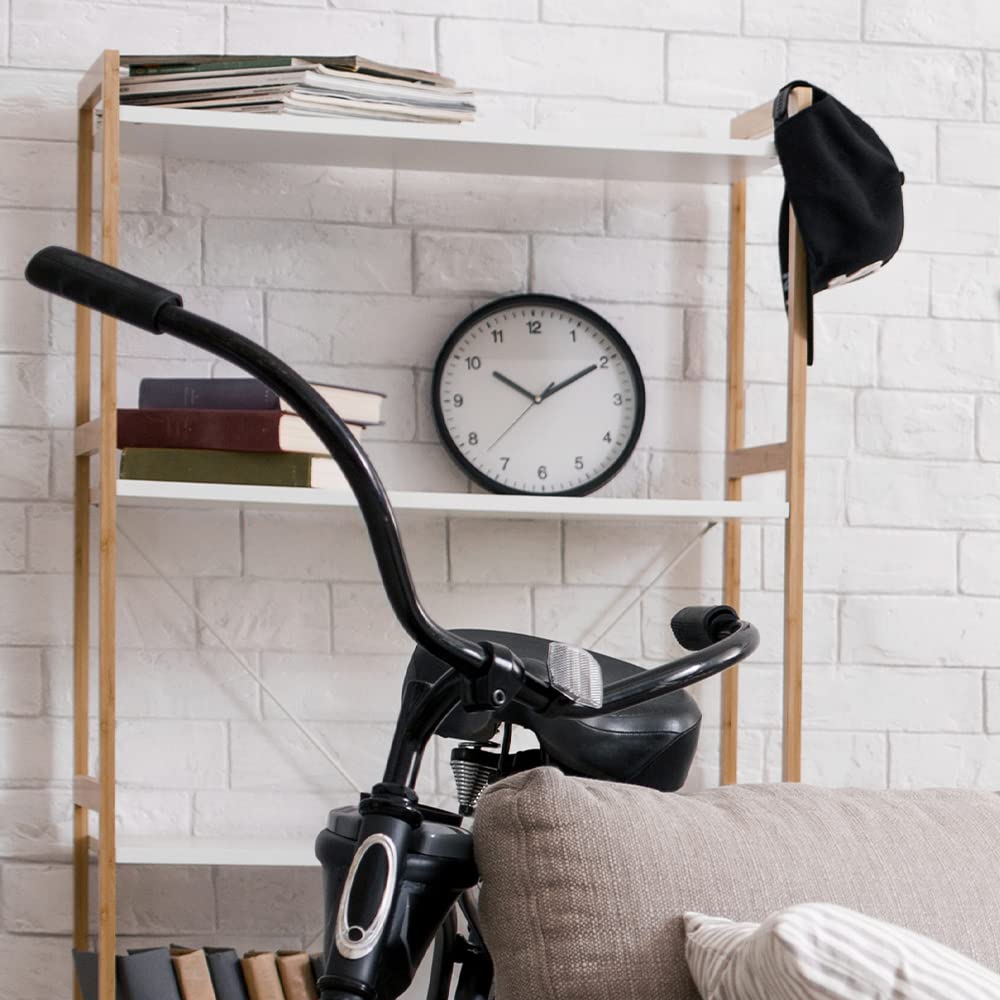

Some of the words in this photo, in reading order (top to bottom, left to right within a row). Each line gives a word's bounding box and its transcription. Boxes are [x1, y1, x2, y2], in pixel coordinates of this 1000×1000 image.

[526, 320, 542, 334] 12
[491, 330, 504, 343] 11
[569, 330, 577, 343] 1
[465, 356, 482, 370] 10
[599, 355, 609, 369] 2
[453, 393, 464, 408] 9
[612, 393, 623, 406] 3
[468, 431, 478, 446] 8
[602, 431, 612, 444] 4
[499, 457, 510, 471] 7
[574, 456, 584, 470] 5
[537, 465, 548, 480] 6
